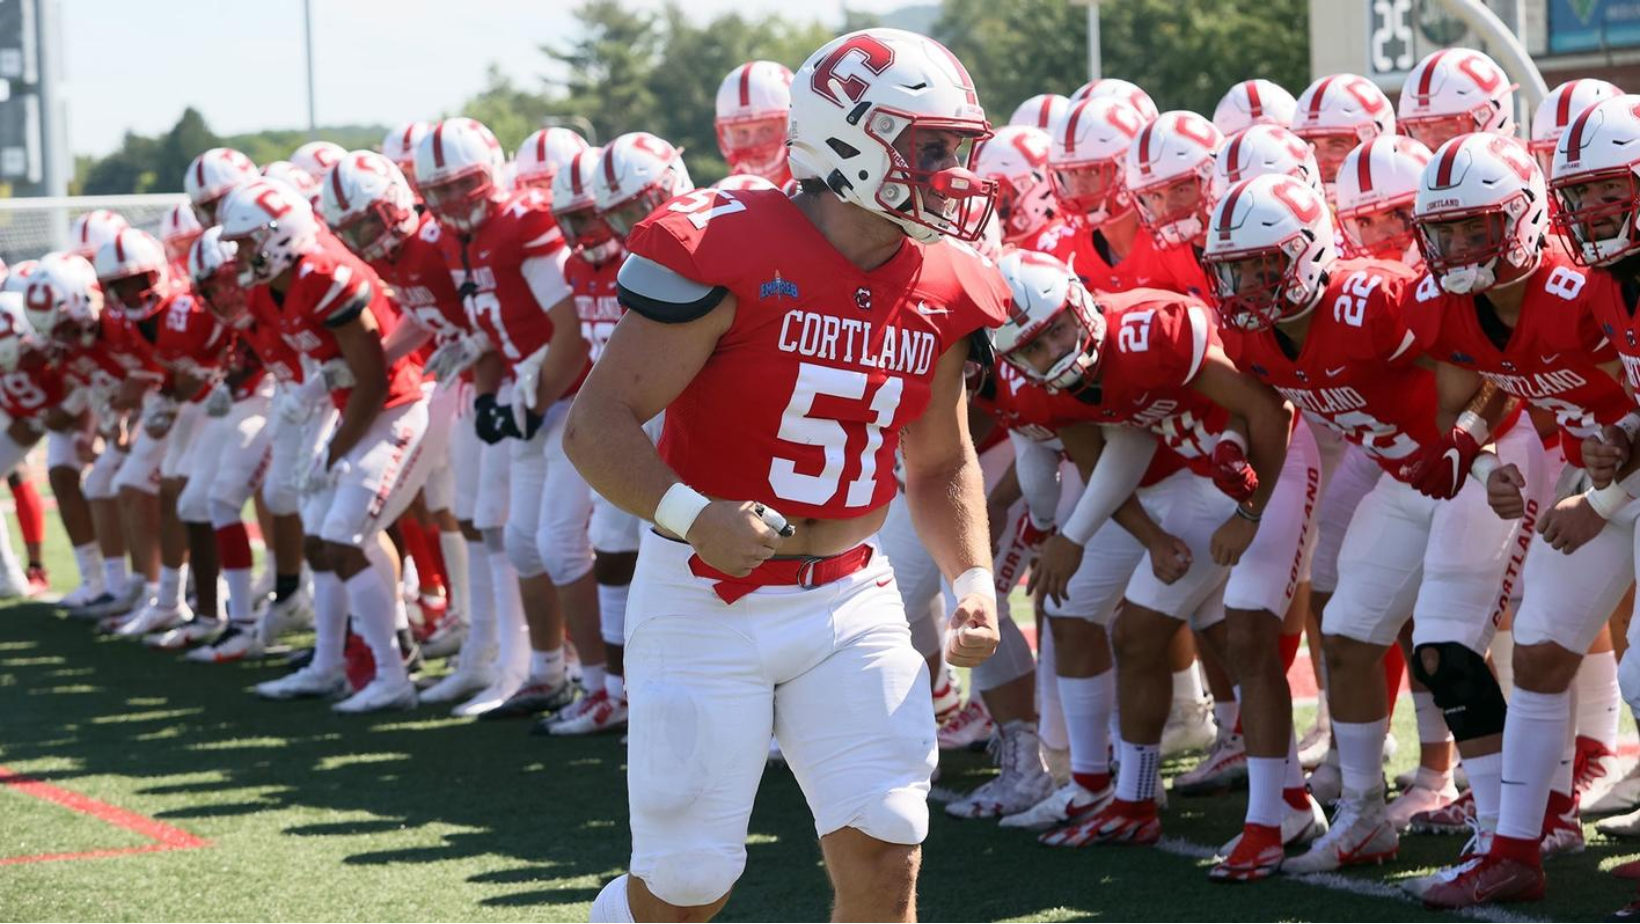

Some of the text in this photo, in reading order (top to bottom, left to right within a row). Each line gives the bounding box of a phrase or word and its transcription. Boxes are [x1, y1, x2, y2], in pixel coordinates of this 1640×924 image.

[811, 34, 895, 109] C
[668, 188, 747, 230] 51
[1333, 270, 1383, 328] 22
[1544, 265, 1587, 301] 8
[778, 310, 936, 376] CORTLAND
[1118, 308, 1157, 354] 21
[768, 362, 904, 508] 51
[1285, 466, 1320, 600] CORTLAND
[1492, 498, 1539, 628] CORTLAND
